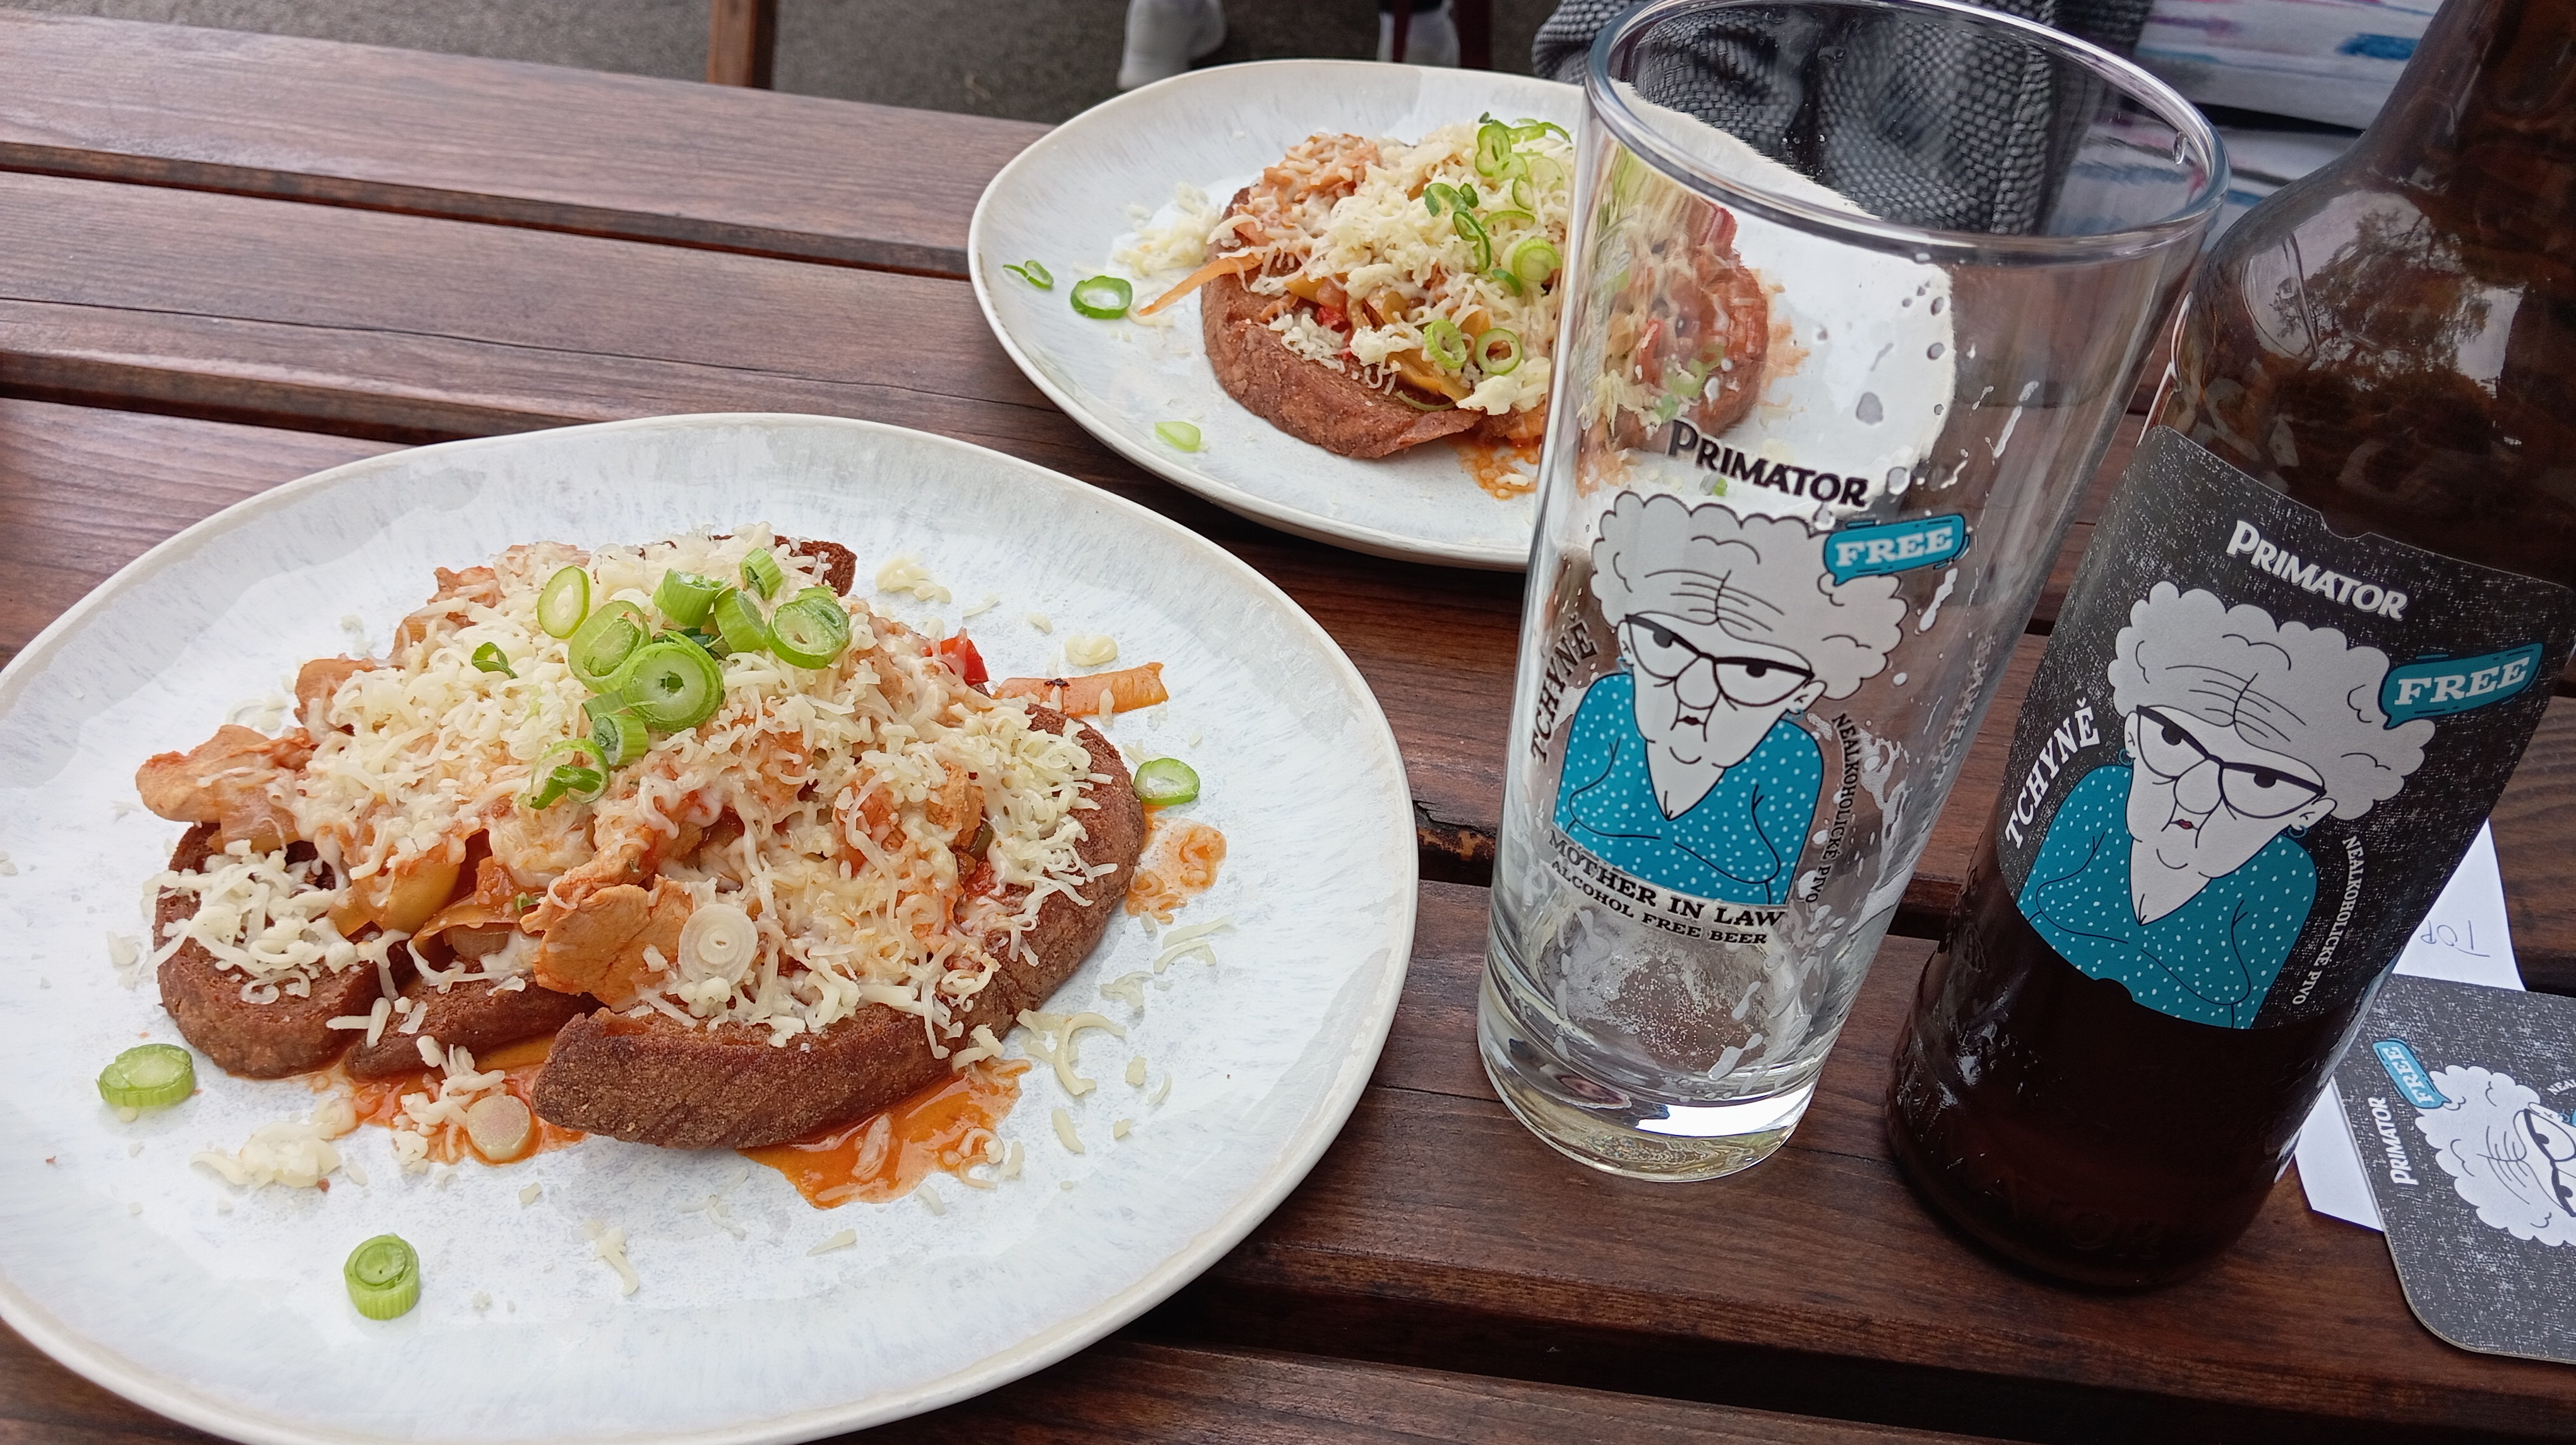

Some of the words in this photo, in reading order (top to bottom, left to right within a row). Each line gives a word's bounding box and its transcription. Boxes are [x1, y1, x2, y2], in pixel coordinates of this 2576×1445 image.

[1668, 419, 1869, 507] PRIMATOR
[1835, 527, 1955, 567] FREE
[2226, 520, 2408, 621] PRIMATOR
[2394, 656, 2530, 705] FREE
[2005, 697, 2101, 849] TCHYNĚ
[1548, 830, 1657, 907] MOTHER
[1667, 897, 1705, 918] IN
[1714, 908, 1786, 926] LAW
[1551, 860, 1634, 918] ALCOHOL
[1642, 912, 1702, 938] FREE
[1709, 930, 1768, 944] BEER
[1805, 864, 1831, 902] PIVO
[2292, 969, 2323, 1005] PIVO
[2382, 1046, 2435, 1103] FREE
[2368, 1096, 2419, 1186] PRIMATOR
